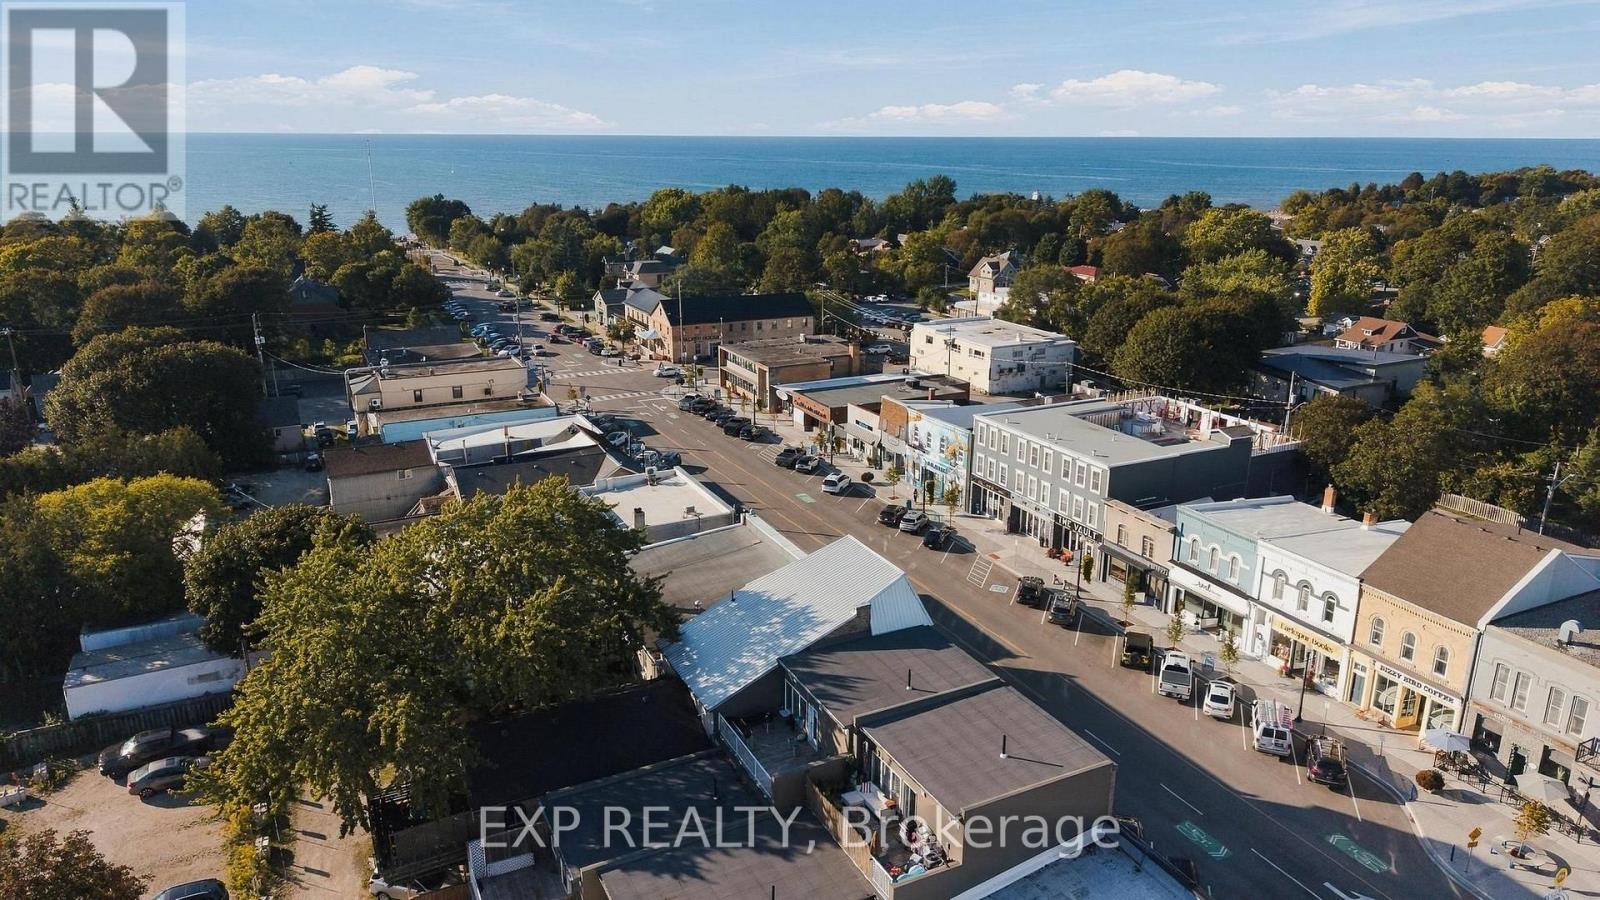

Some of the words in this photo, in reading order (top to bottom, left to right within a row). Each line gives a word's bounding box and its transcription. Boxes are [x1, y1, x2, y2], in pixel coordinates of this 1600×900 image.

[1058, 516, 1072, 528] THE
[1074, 523, 1097, 539] VAULT
[1403, 676, 1422, 689] BIRD
[1423, 685, 1455, 704] COFFEE
